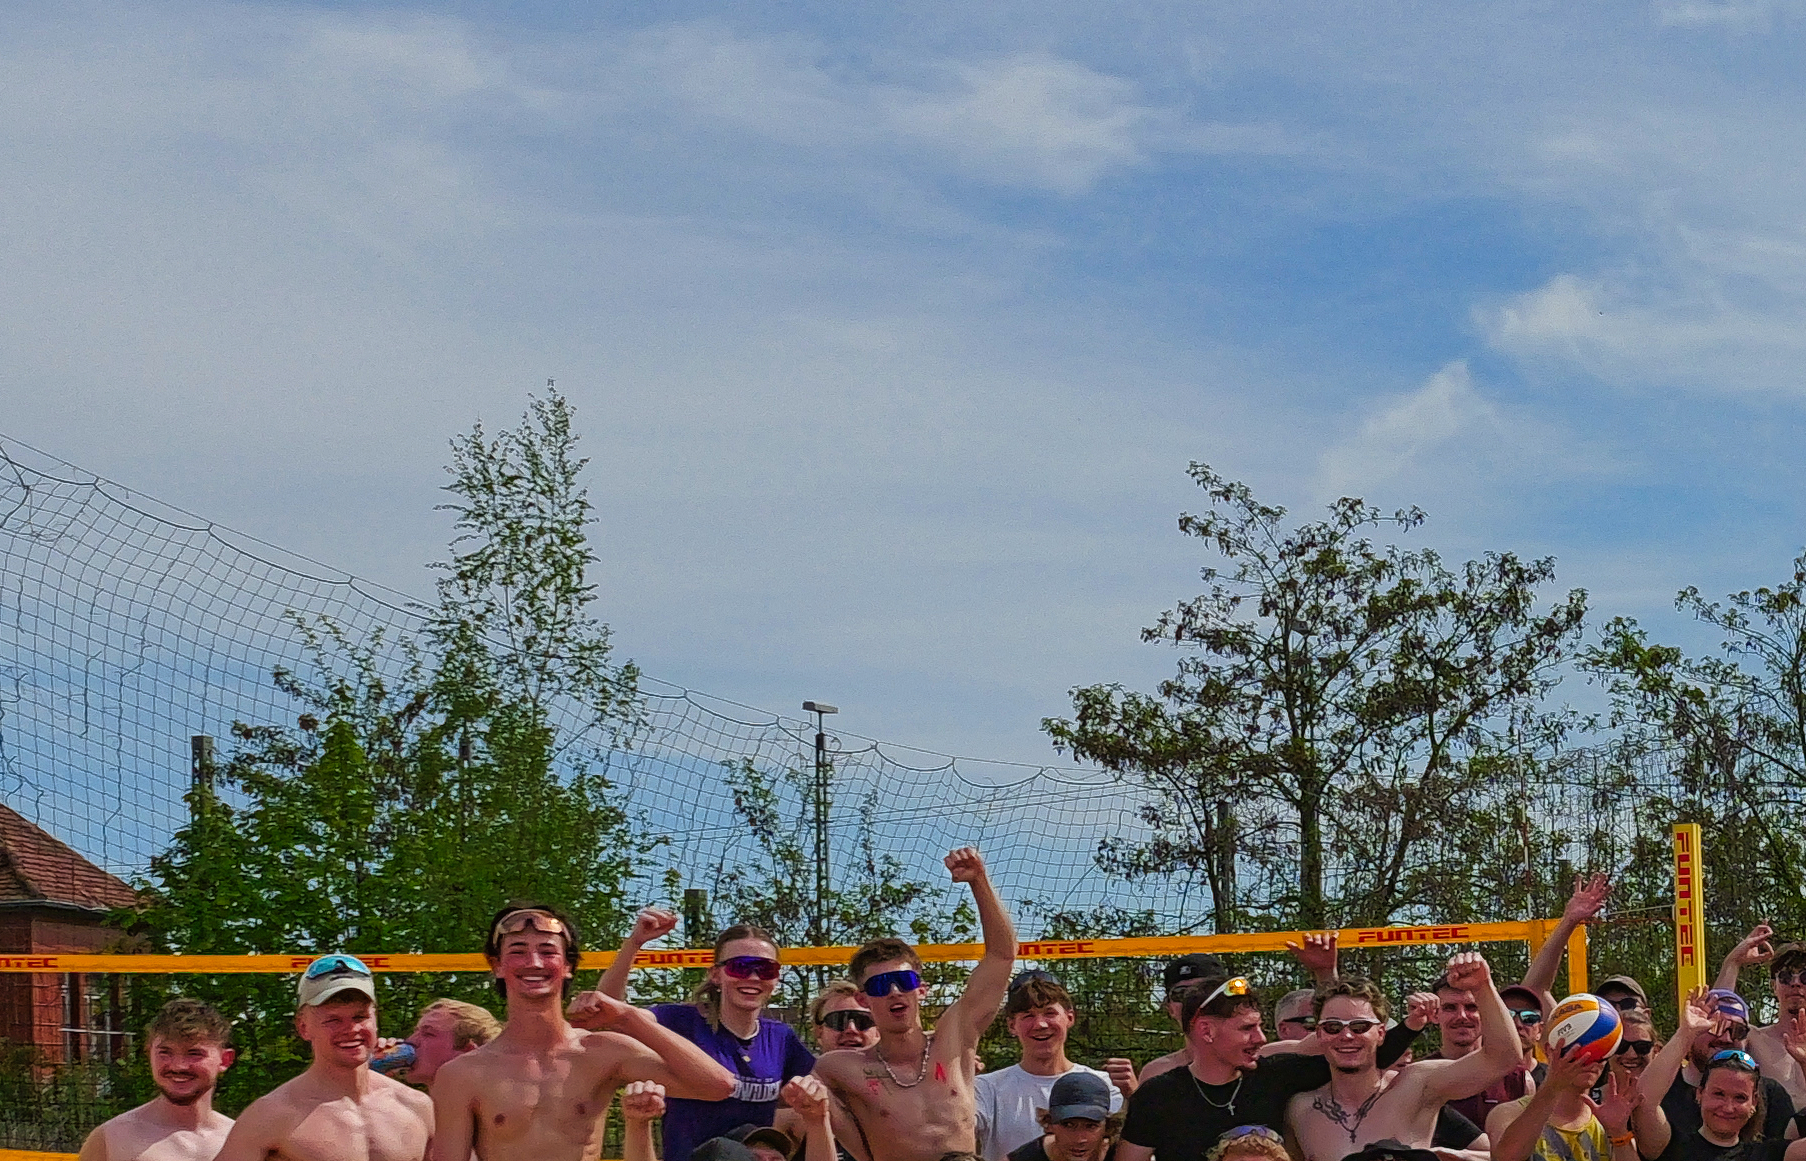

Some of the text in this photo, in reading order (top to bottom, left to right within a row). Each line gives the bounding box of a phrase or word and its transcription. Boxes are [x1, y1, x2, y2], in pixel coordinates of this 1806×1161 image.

[1676, 832, 1693, 967] FUNTEC
[1358, 926, 1469, 943] FUNTEC
[1018, 942, 1095, 956] NTEC
[0, 957, 59, 968] NTEC
[634, 952, 715, 965] FUNTE
